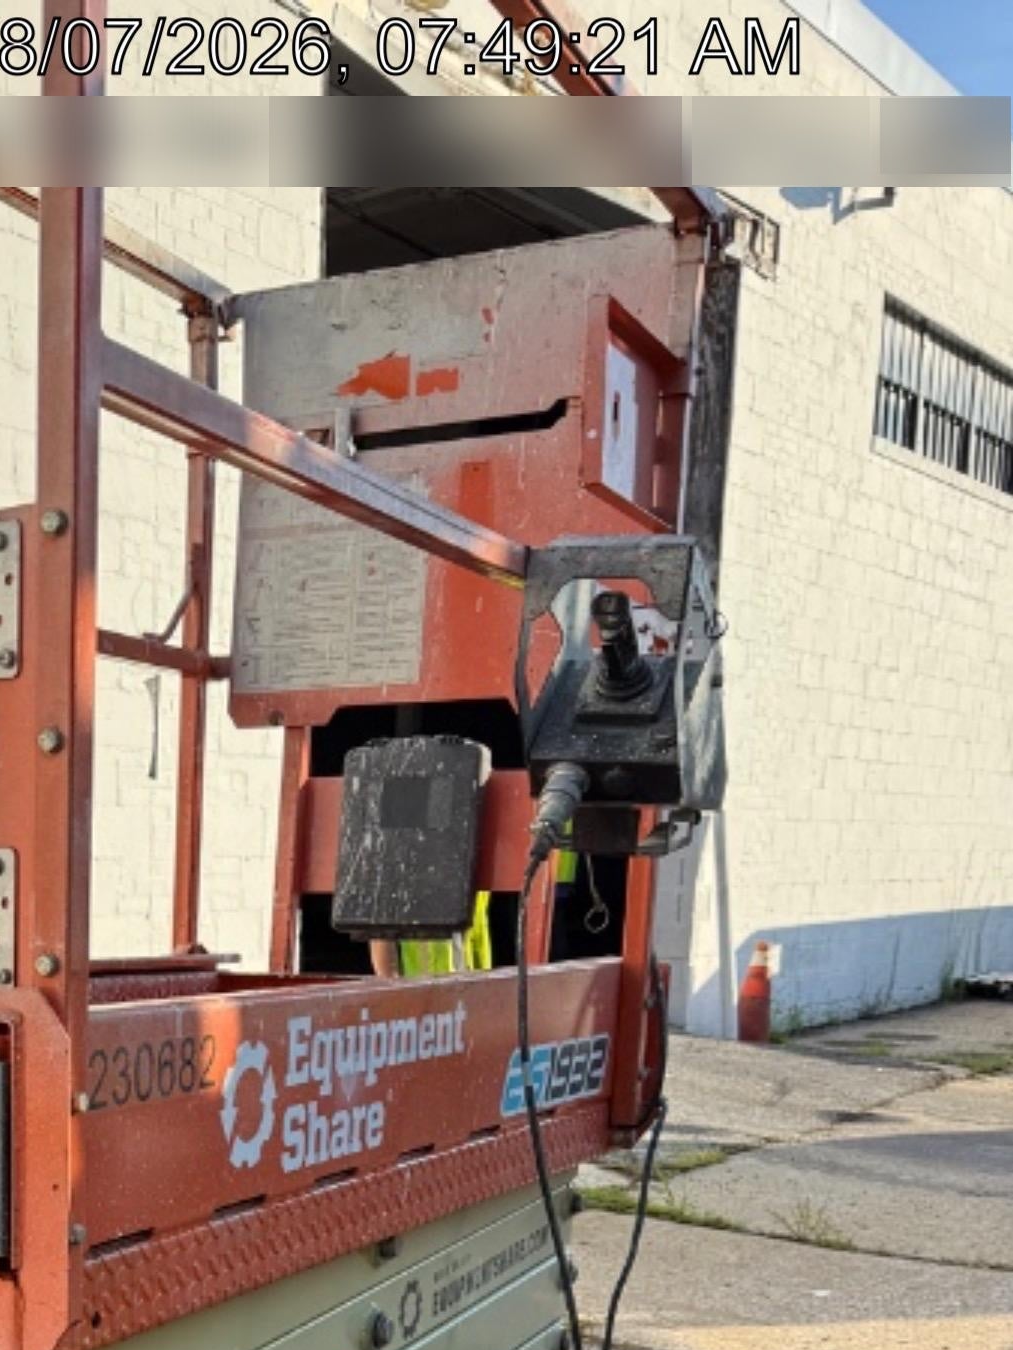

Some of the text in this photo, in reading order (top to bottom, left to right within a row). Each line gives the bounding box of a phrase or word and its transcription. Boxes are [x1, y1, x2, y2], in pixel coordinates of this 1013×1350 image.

[88, 1035, 216, 1110] 230682
[287, 1002, 467, 1096] Equipment
[281, 1100, 385, 1174] Share
